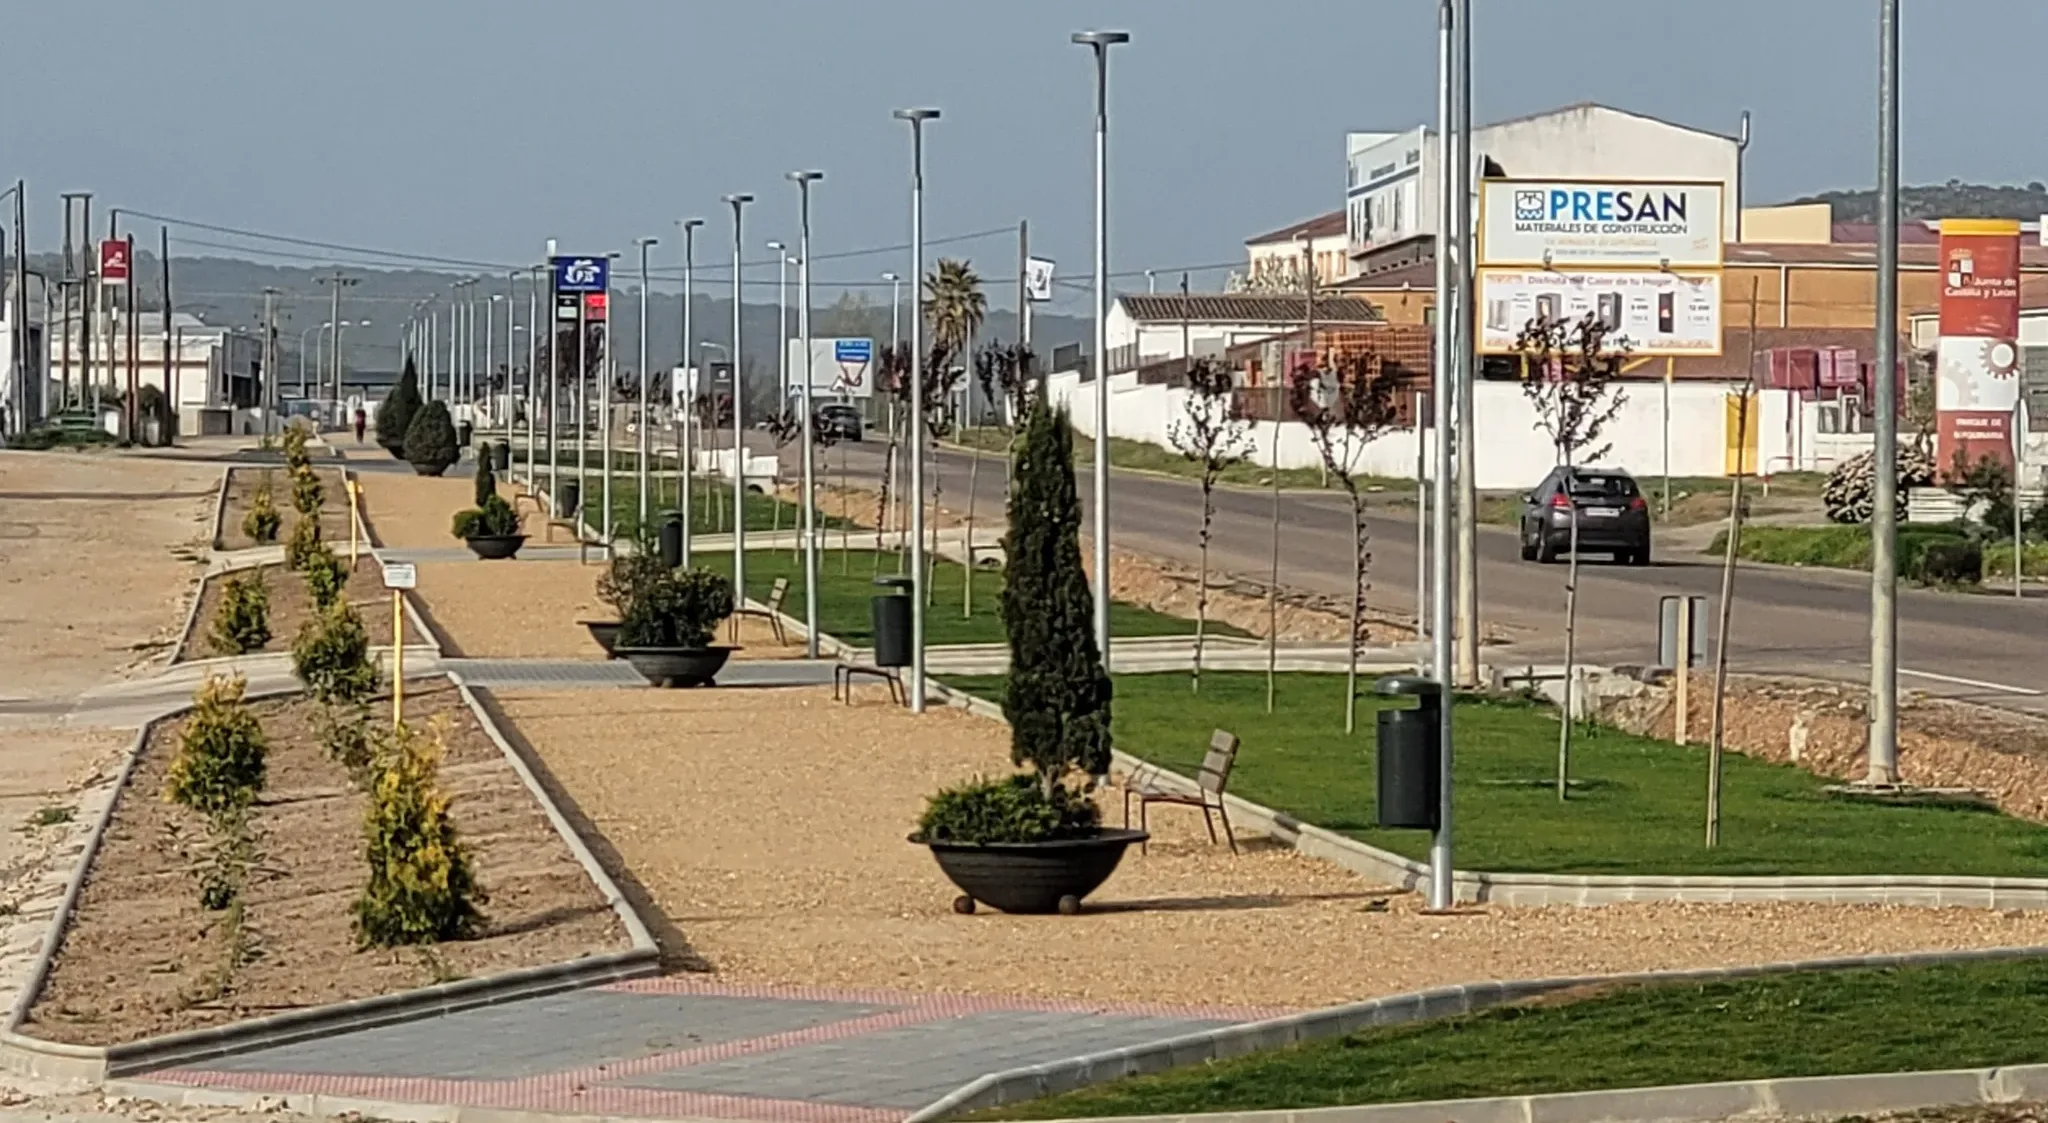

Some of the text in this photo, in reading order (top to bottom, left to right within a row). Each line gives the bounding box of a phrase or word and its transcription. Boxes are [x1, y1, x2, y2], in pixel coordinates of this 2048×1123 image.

[1550, 189, 1687, 222] PRESAN
[1515, 222, 1688, 234] MATERIALES DE CONSTRUCCIÓN
[1528, 275, 1567, 285] Disfruta
[1587, 276, 1613, 286] Calor
[1615, 276, 1628, 286] de
[1630, 277, 1640, 286] tu
[1642, 277, 1672, 288] Hogar
[1974, 277, 2017, 287] Junta de
[1944, 286, 1982, 297] Castilla
[1984, 289, 1991, 299] y
